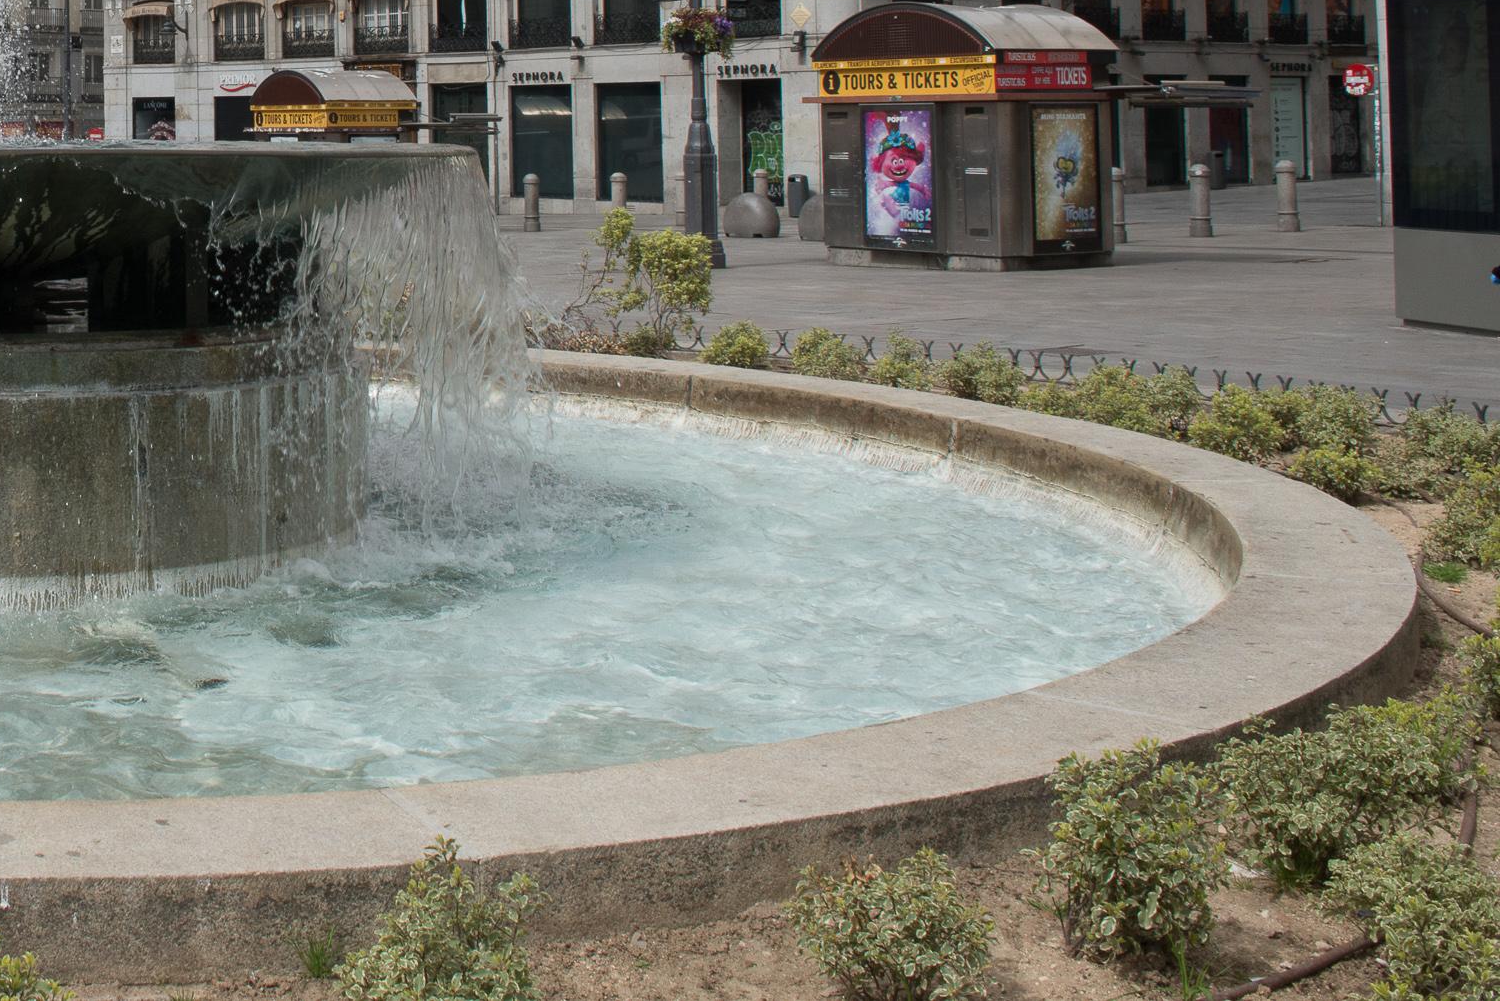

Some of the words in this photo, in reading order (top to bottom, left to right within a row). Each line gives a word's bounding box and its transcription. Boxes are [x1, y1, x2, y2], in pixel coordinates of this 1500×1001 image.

[717, 63, 779, 78] SEPHORA
[1270, 62, 1313, 72] SEPHORA
[219, 73, 257, 85] PRIMOR
[512, 71, 565, 84] SEPHORA
[842, 73, 884, 91] TOURS
[887, 73, 898, 91] &
[902, 71, 960, 90] TICKETS
[962, 69, 993, 87] OFFICIAL
[1055, 66, 1087, 85] TICKETS
[264, 113, 282, 125] TOURS
[289, 112, 313, 124] TICKETS
[340, 114, 361, 123] TOURS
[370, 113, 397, 123] TICKETS
[925, 207, 932, 222] 2
